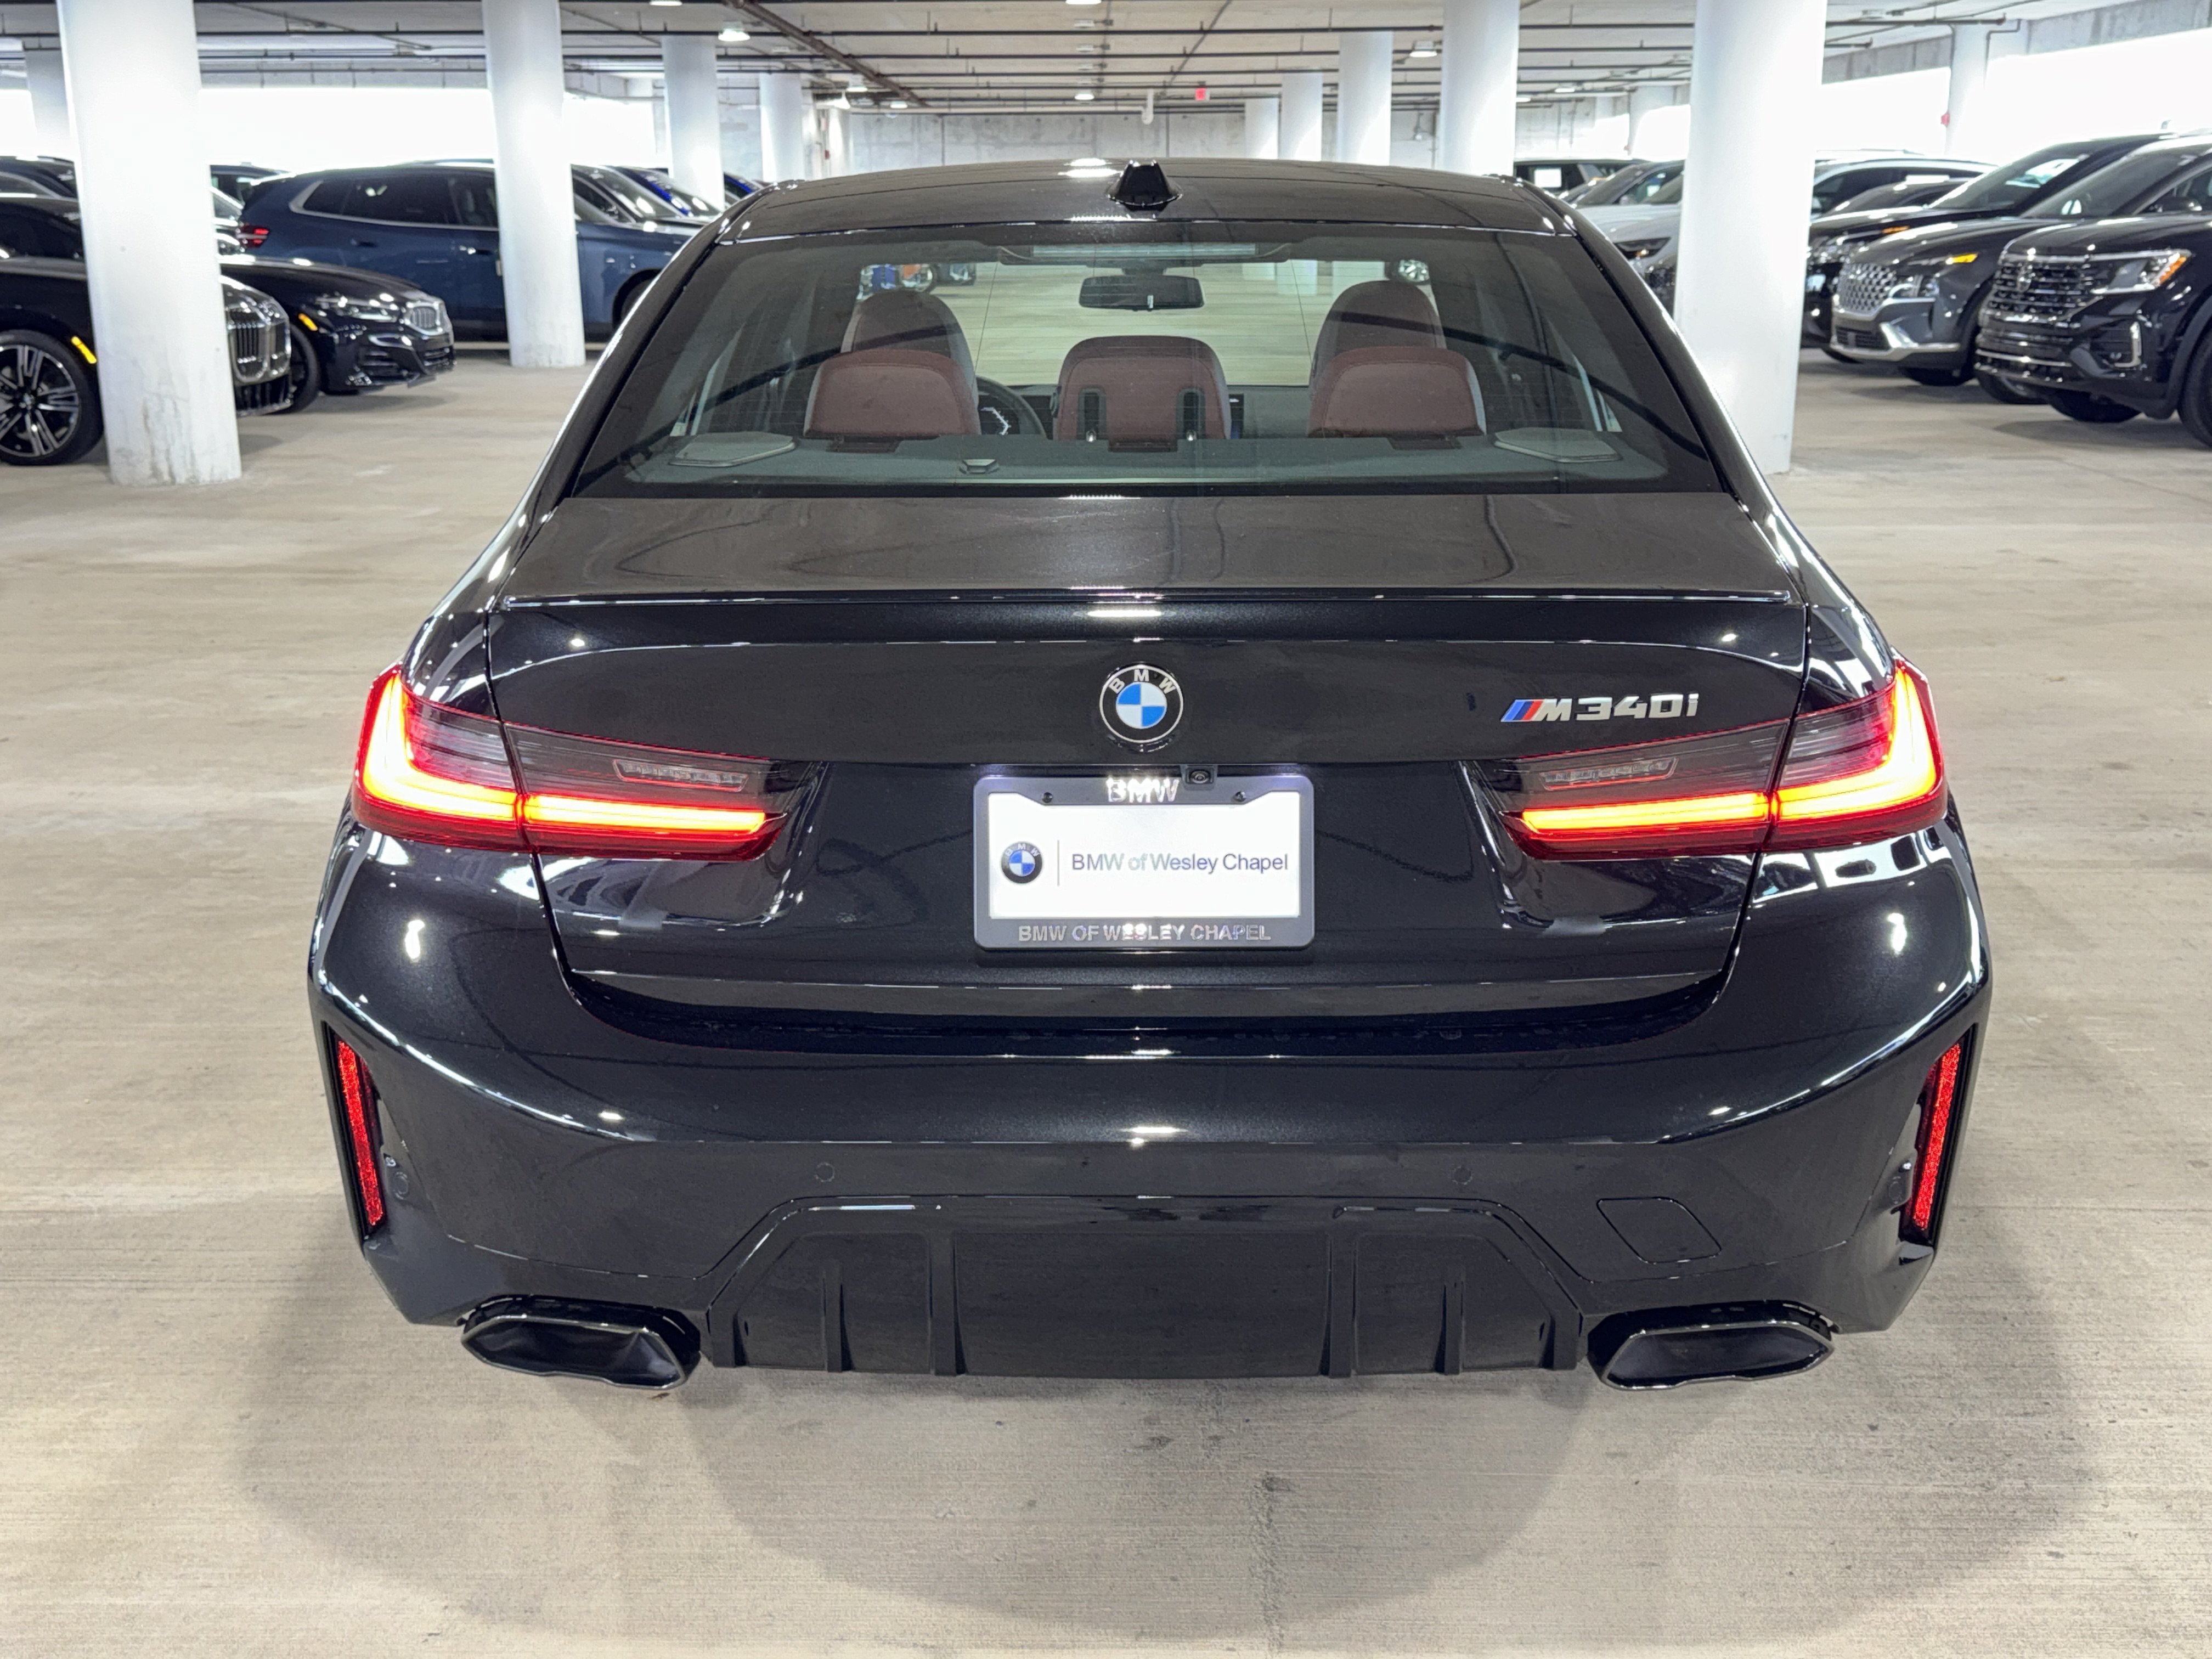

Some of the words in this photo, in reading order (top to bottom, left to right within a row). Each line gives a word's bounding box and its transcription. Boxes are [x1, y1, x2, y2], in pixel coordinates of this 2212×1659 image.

[1108, 669, 1176, 694] BMW
[1105, 777, 1180, 803] BMW
[1005, 843, 1041, 857] BMW
[1071, 853, 1125, 871] BMW
[1128, 853, 1148, 871] of
[1149, 853, 1218, 875] Wesley
[1222, 853, 1288, 874] Chapel
[1018, 925, 1067, 941] BMW
[1072, 925, 1099, 941] OF
[1103, 923, 1184, 941] WESLEY
[1190, 924, 1271, 940] CHAPEL
